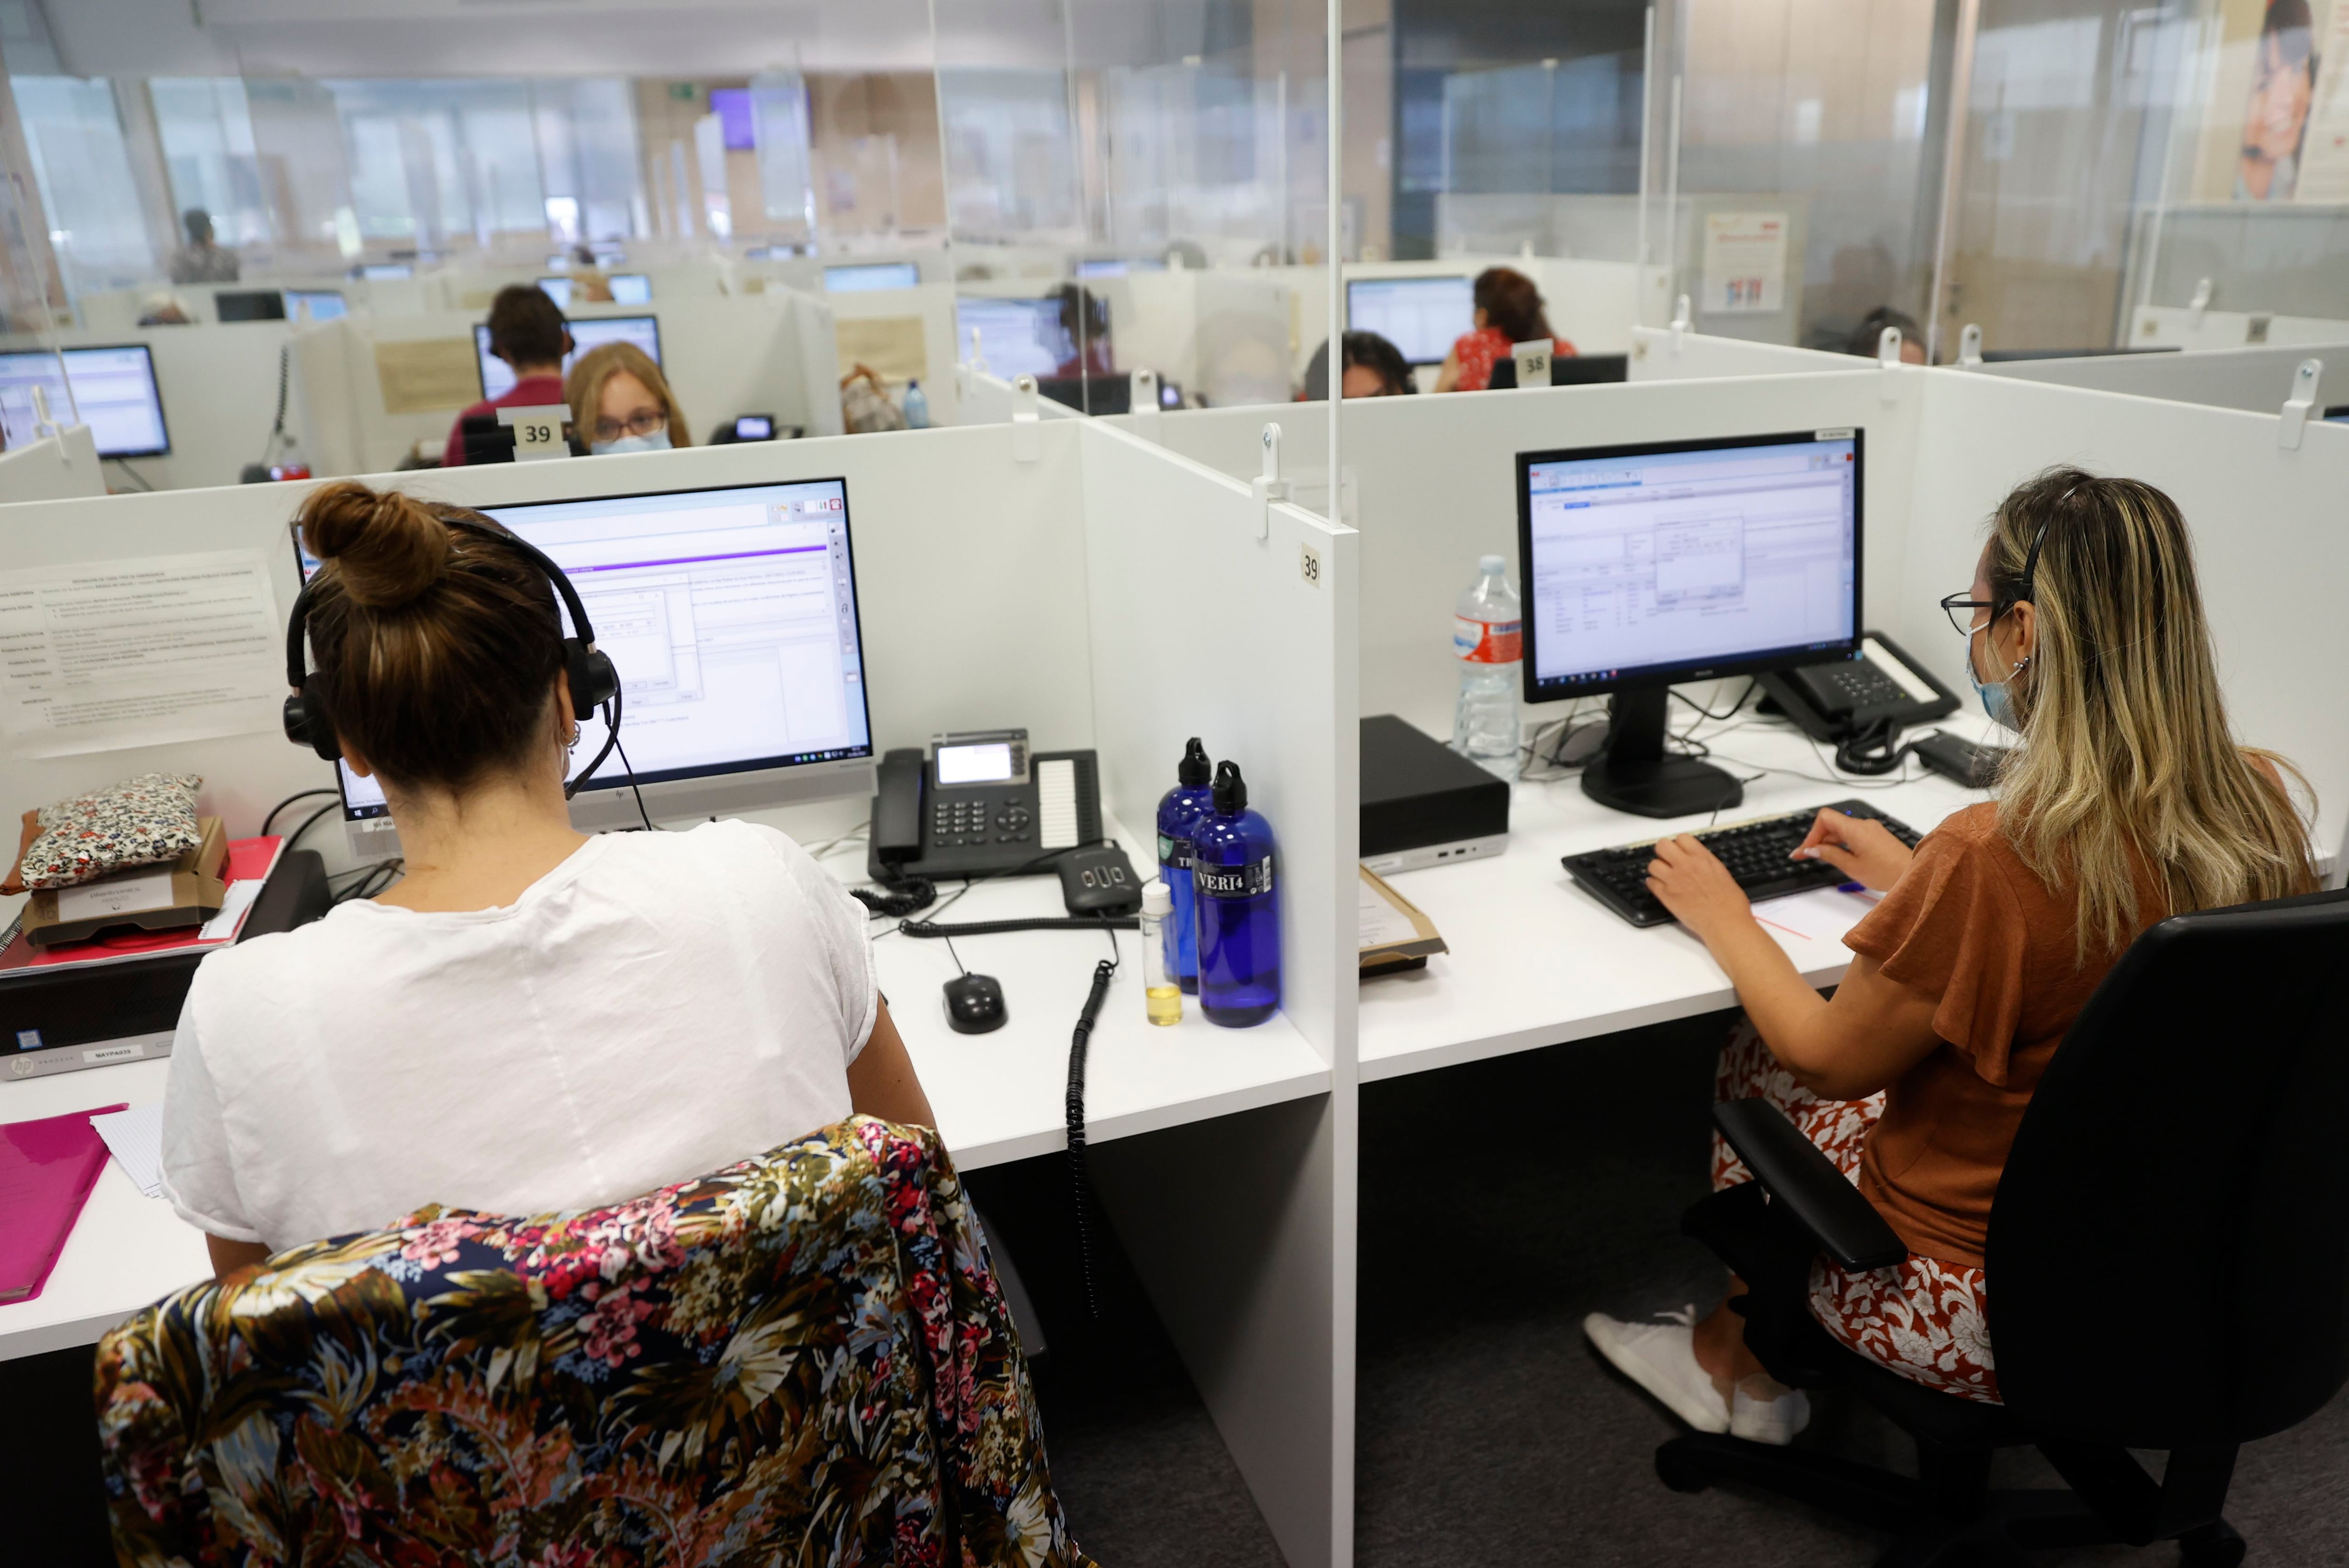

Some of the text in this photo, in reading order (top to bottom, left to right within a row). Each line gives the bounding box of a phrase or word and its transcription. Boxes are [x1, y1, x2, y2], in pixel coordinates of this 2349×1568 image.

[1526, 356, 1545, 373] 38
[525, 425, 551, 443] 39
[1305, 555, 1317, 580] 39
[1198, 872, 1244, 891] VERI4
[15, 1057, 31, 1075] hp
